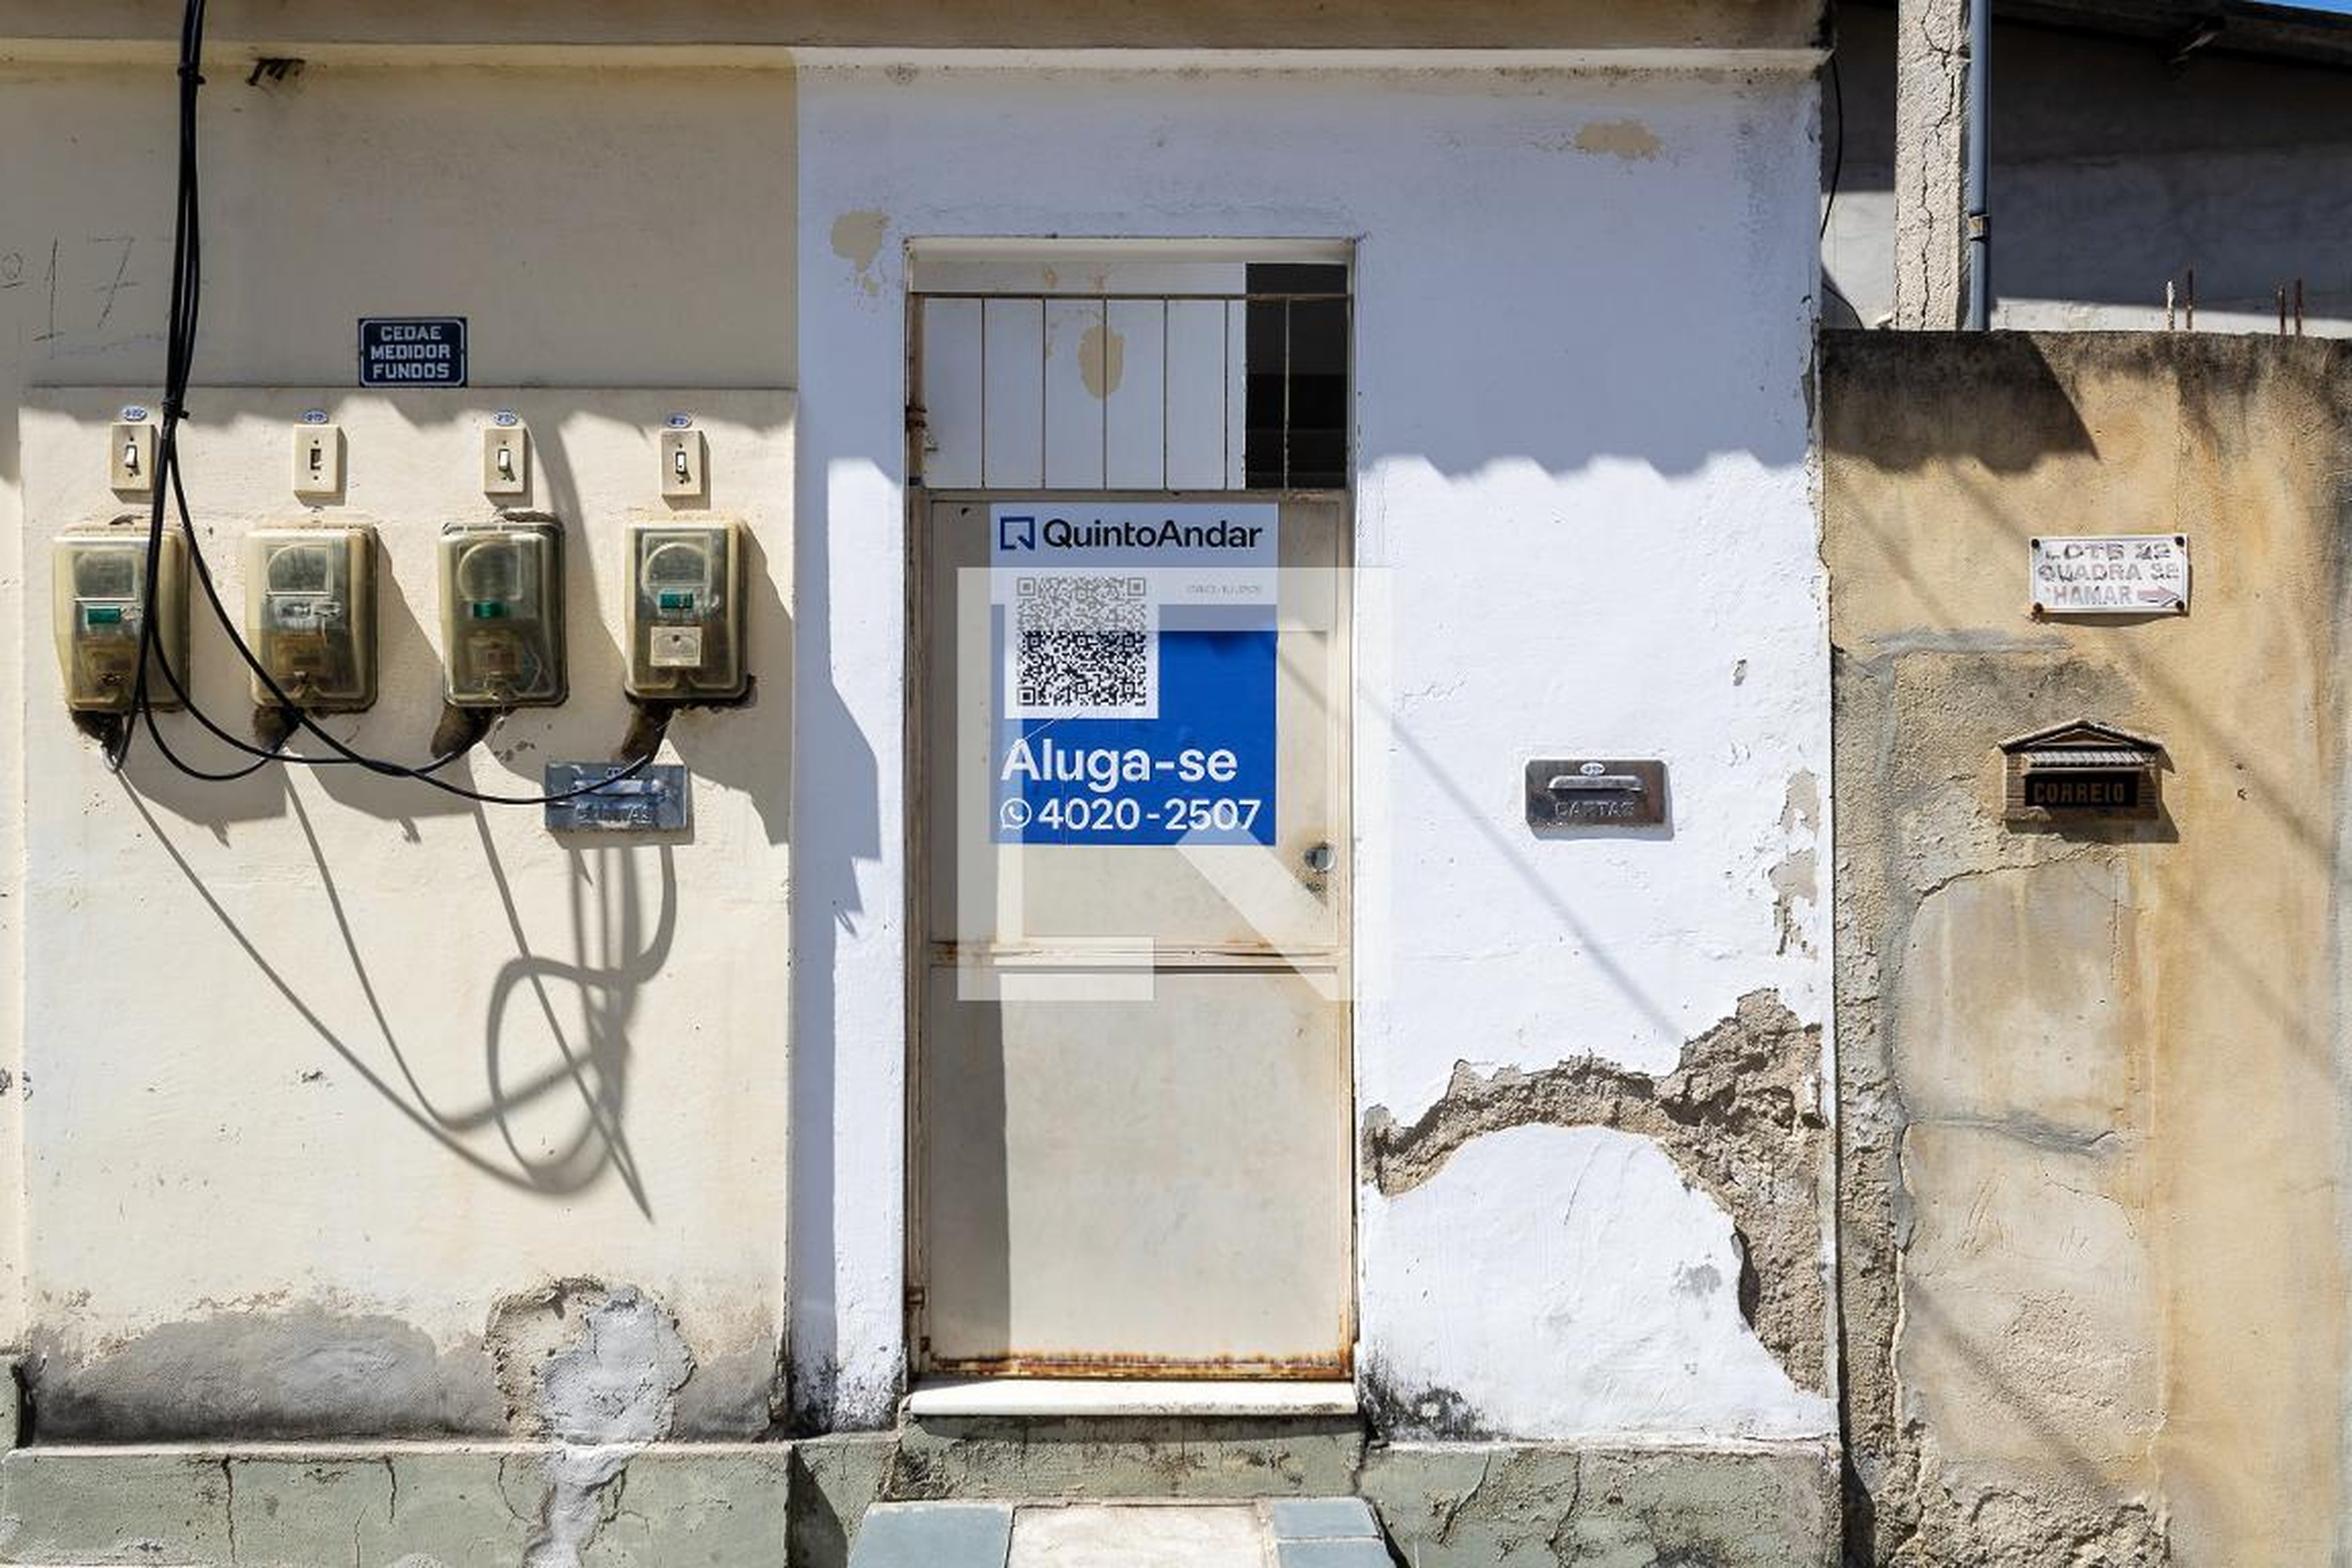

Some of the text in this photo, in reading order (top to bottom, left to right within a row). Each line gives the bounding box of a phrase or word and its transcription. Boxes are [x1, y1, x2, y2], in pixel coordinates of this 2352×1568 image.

[380, 326, 442, 341] CEDAE
[371, 344, 450, 360] MEDIDOR
[372, 363, 450, 379] FUNDOS
[1042, 518, 1262, 549] QuintoAndar
[2038, 563, 2143, 582] QUADRA
[1000, 737, 1238, 793] Aluga-se
[2033, 782, 2125, 804] CORREIO
[1038, 798, 1261, 831] 4020-2507
